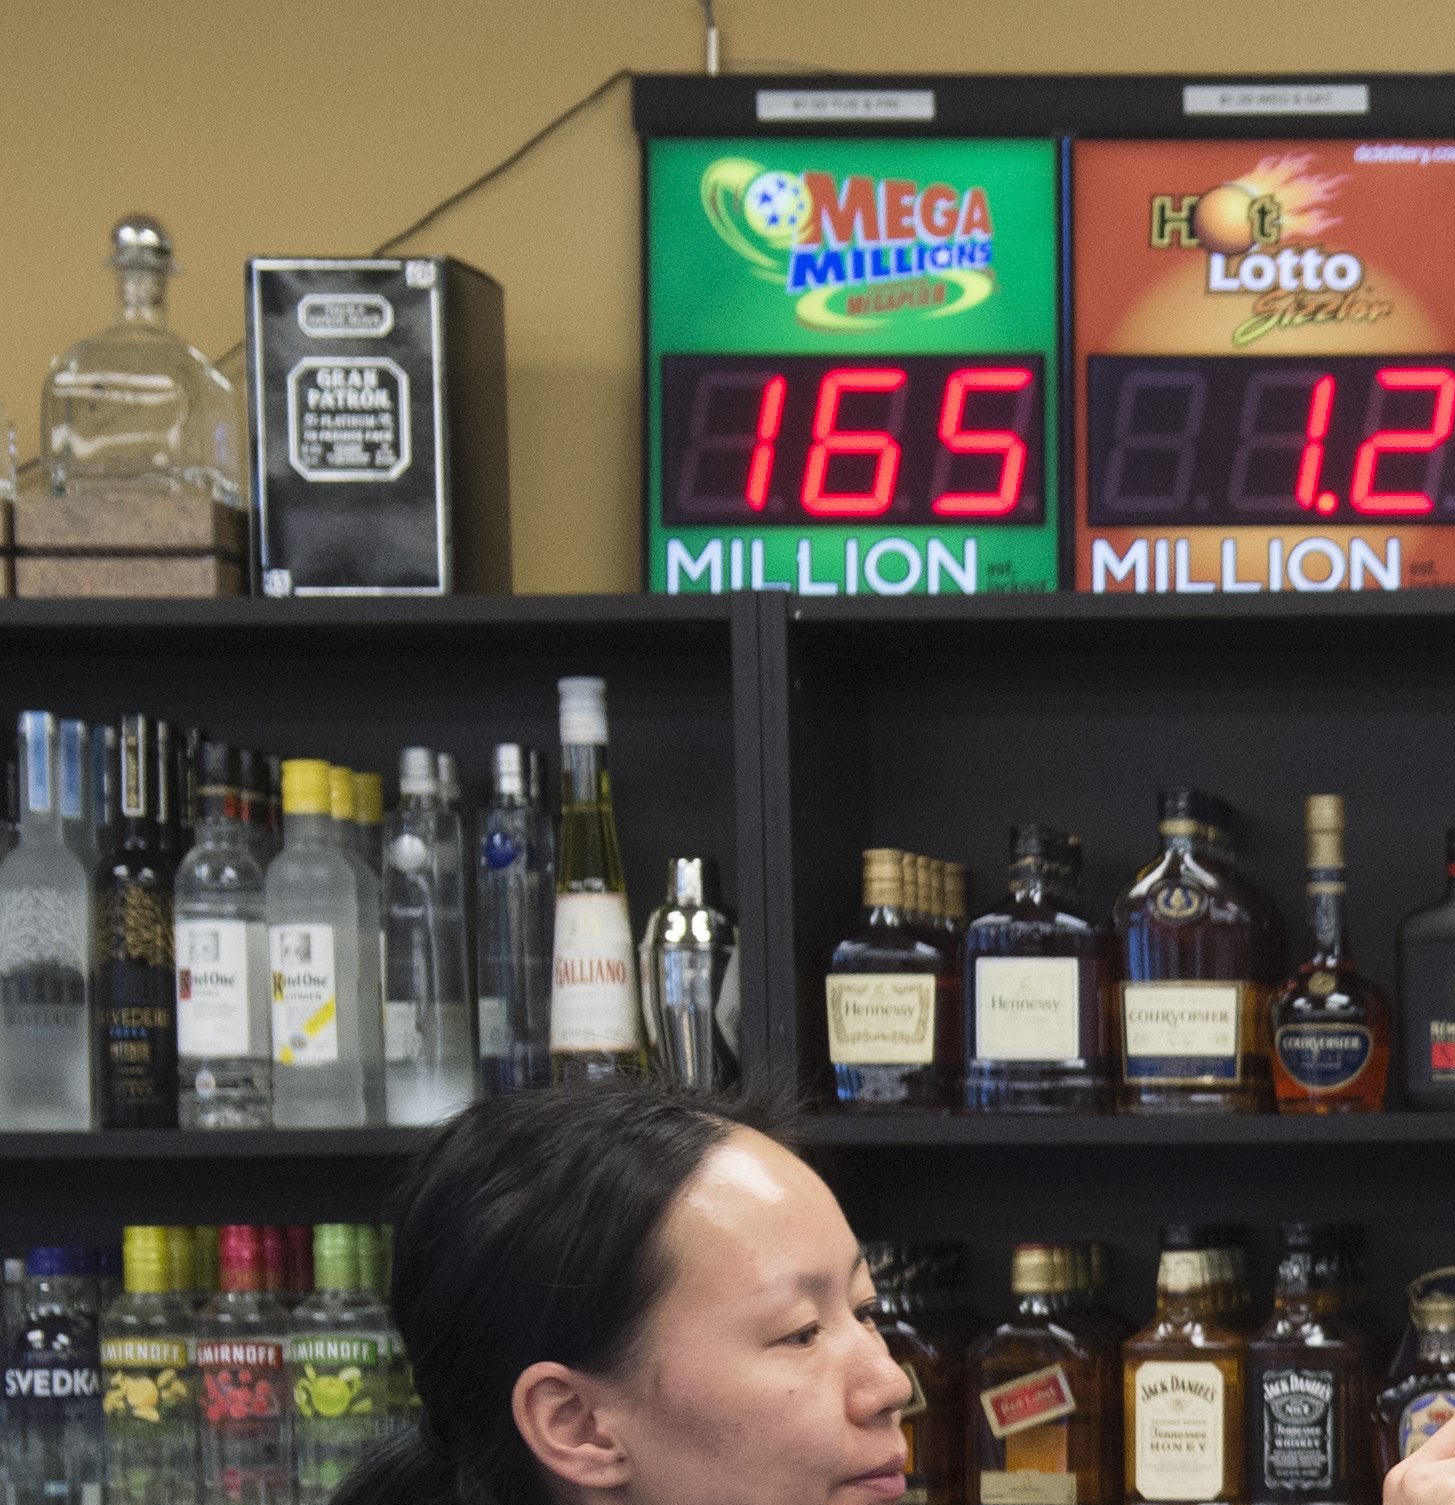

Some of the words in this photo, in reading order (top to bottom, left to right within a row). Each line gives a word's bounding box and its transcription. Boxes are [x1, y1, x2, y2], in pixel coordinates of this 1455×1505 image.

[797, 170, 993, 246] MEGA
[788, 240, 993, 292] MILLIONS
[1207, 247, 1363, 293] Lotto
[316, 367, 379, 389] GRAN
[744, 366, 1034, 518] 165
[666, 537, 979, 596] MILLION
[1092, 536, 1401, 593] MILLION
[555, 955, 627, 989] GALLIANO
[844, 1000, 915, 1020] Hennessy
[990, 994, 1061, 1014] Hennessy
[1128, 1008, 1230, 1028] COURVOISIER
[1281, 1035, 1363, 1053] COURVOISIER
[4, 1367, 99, 1398] SVEDKA
[1141, 1379, 1168, 1404] JACK
[1263, 1378, 1289, 1401] JACK
[1150, 1441, 1207, 1454] HONEY
